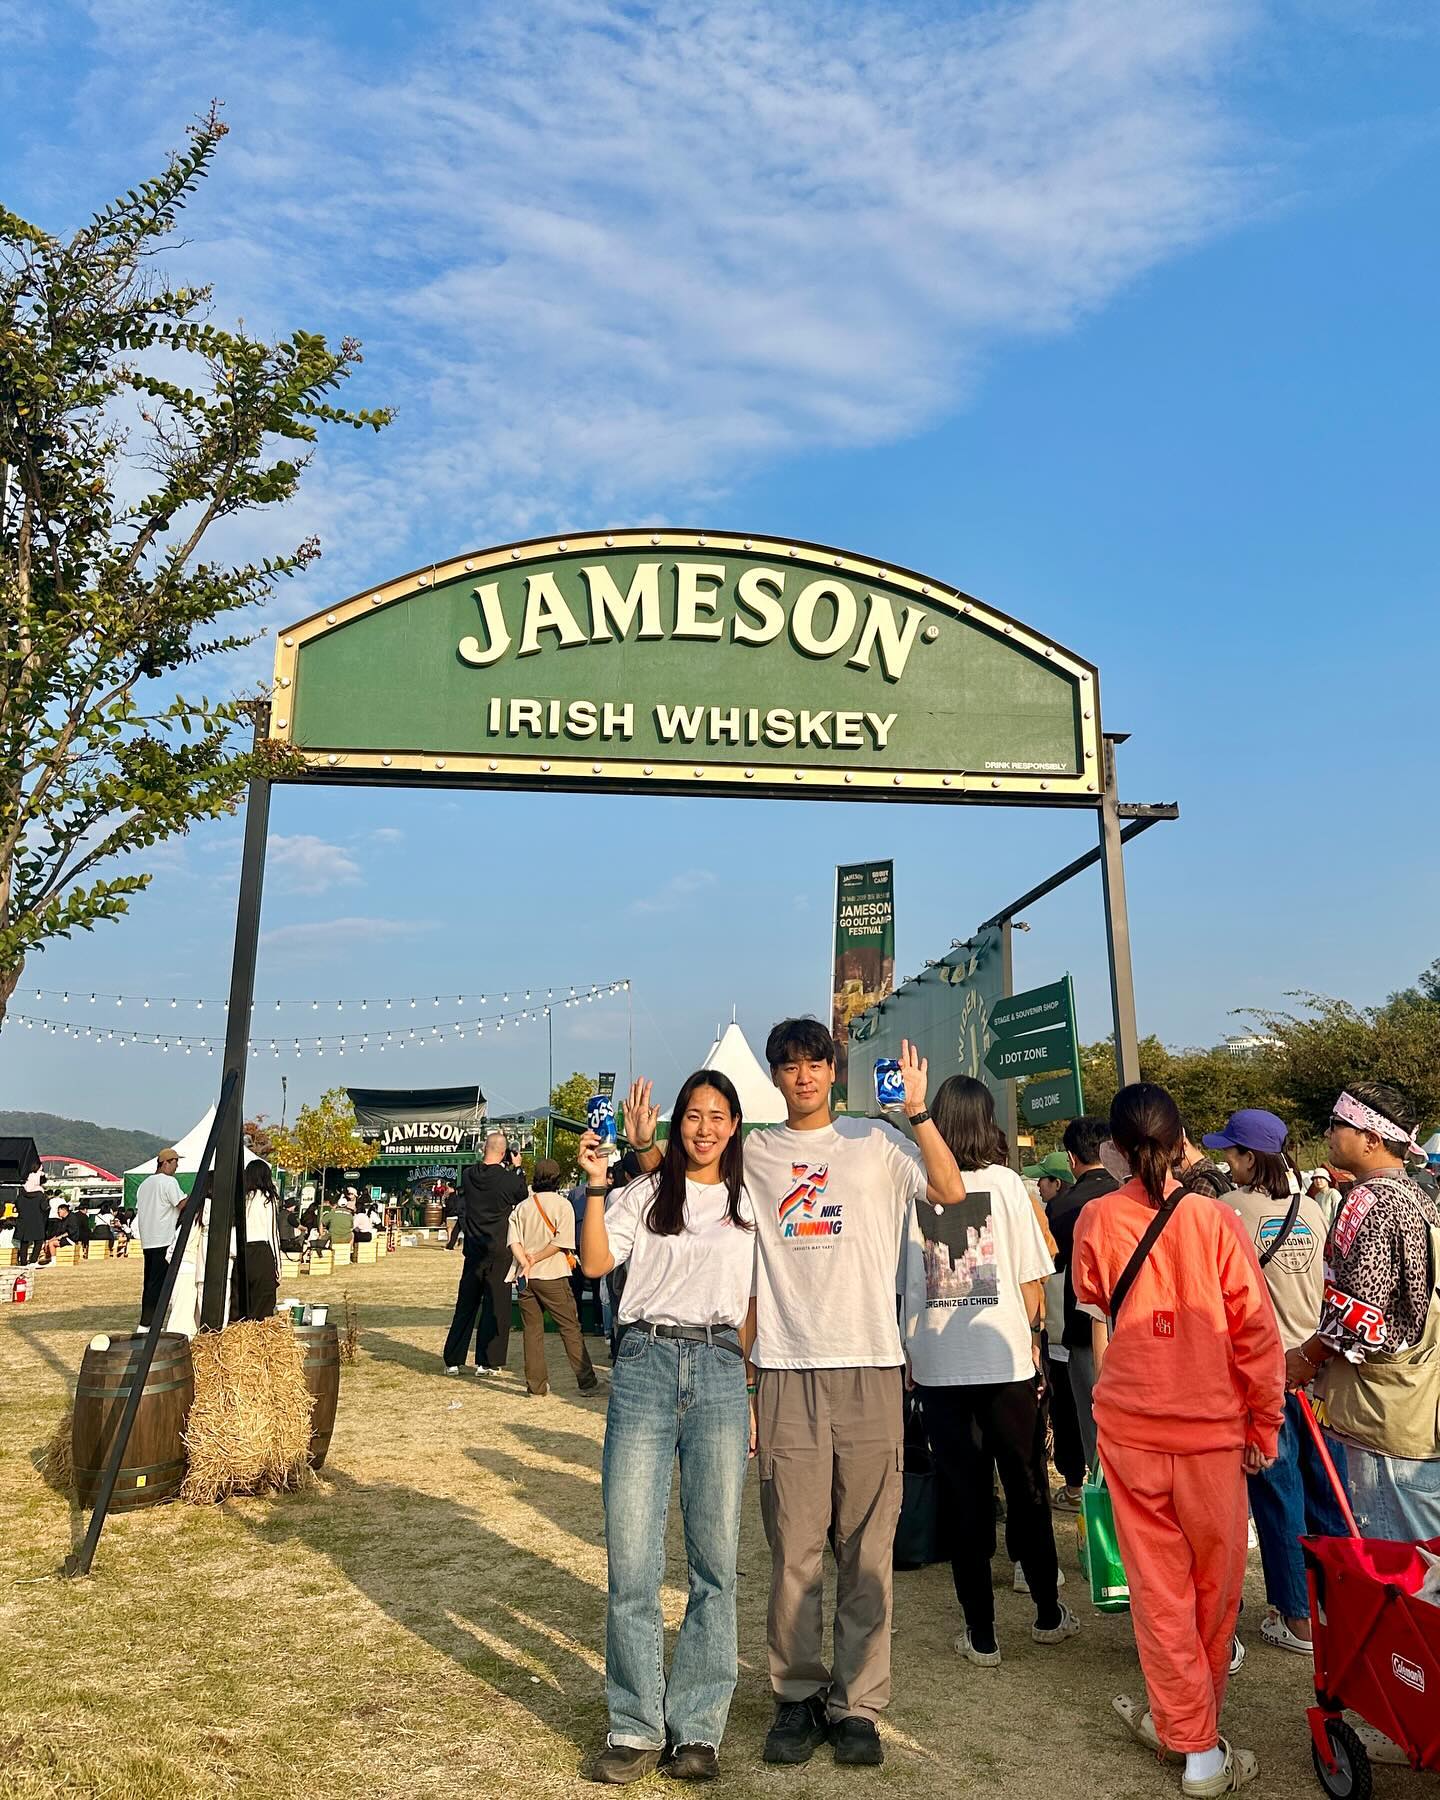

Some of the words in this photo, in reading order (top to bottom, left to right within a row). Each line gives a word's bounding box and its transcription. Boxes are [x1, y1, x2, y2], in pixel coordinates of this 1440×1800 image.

[457, 562, 927, 683] JAMESON
[488, 697, 634, 738] IRISH
[656, 703, 898, 748] WHISKEY
[985, 761, 1010, 769] DRINK
[1011, 762, 1067, 770] RESPONSIBLY
[840, 901, 892, 918] JAMESON
[840, 918, 853, 928] GO
[853, 916, 869, 926] OUT
[870, 915, 892, 925] CAMP
[848, 925, 883, 936] FESTIVAL
[994, 1014, 1011, 1026] STAGE
[1015, 1004, 1043, 1020] SOUVENIR
[1043, 1000, 1060, 1014] SHOP
[999, 1055, 1004, 1065] J
[1005, 1051, 1023, 1063] DOT
[1024, 1047, 1048, 1061] ZONE
[1031, 1098, 1045, 1110] BBQ
[1044, 1093, 1060, 1107] ZONE
[381, 1122, 465, 1146] JAMESON
[385, 1145, 412, 1153] IRISH
[414, 1144, 458, 1153] WHISKEY
[820, 1205, 842, 1218] NIKE
[784, 1220, 842, 1237] RUNNING
[970, 1297, 999, 1306] CHAOS
